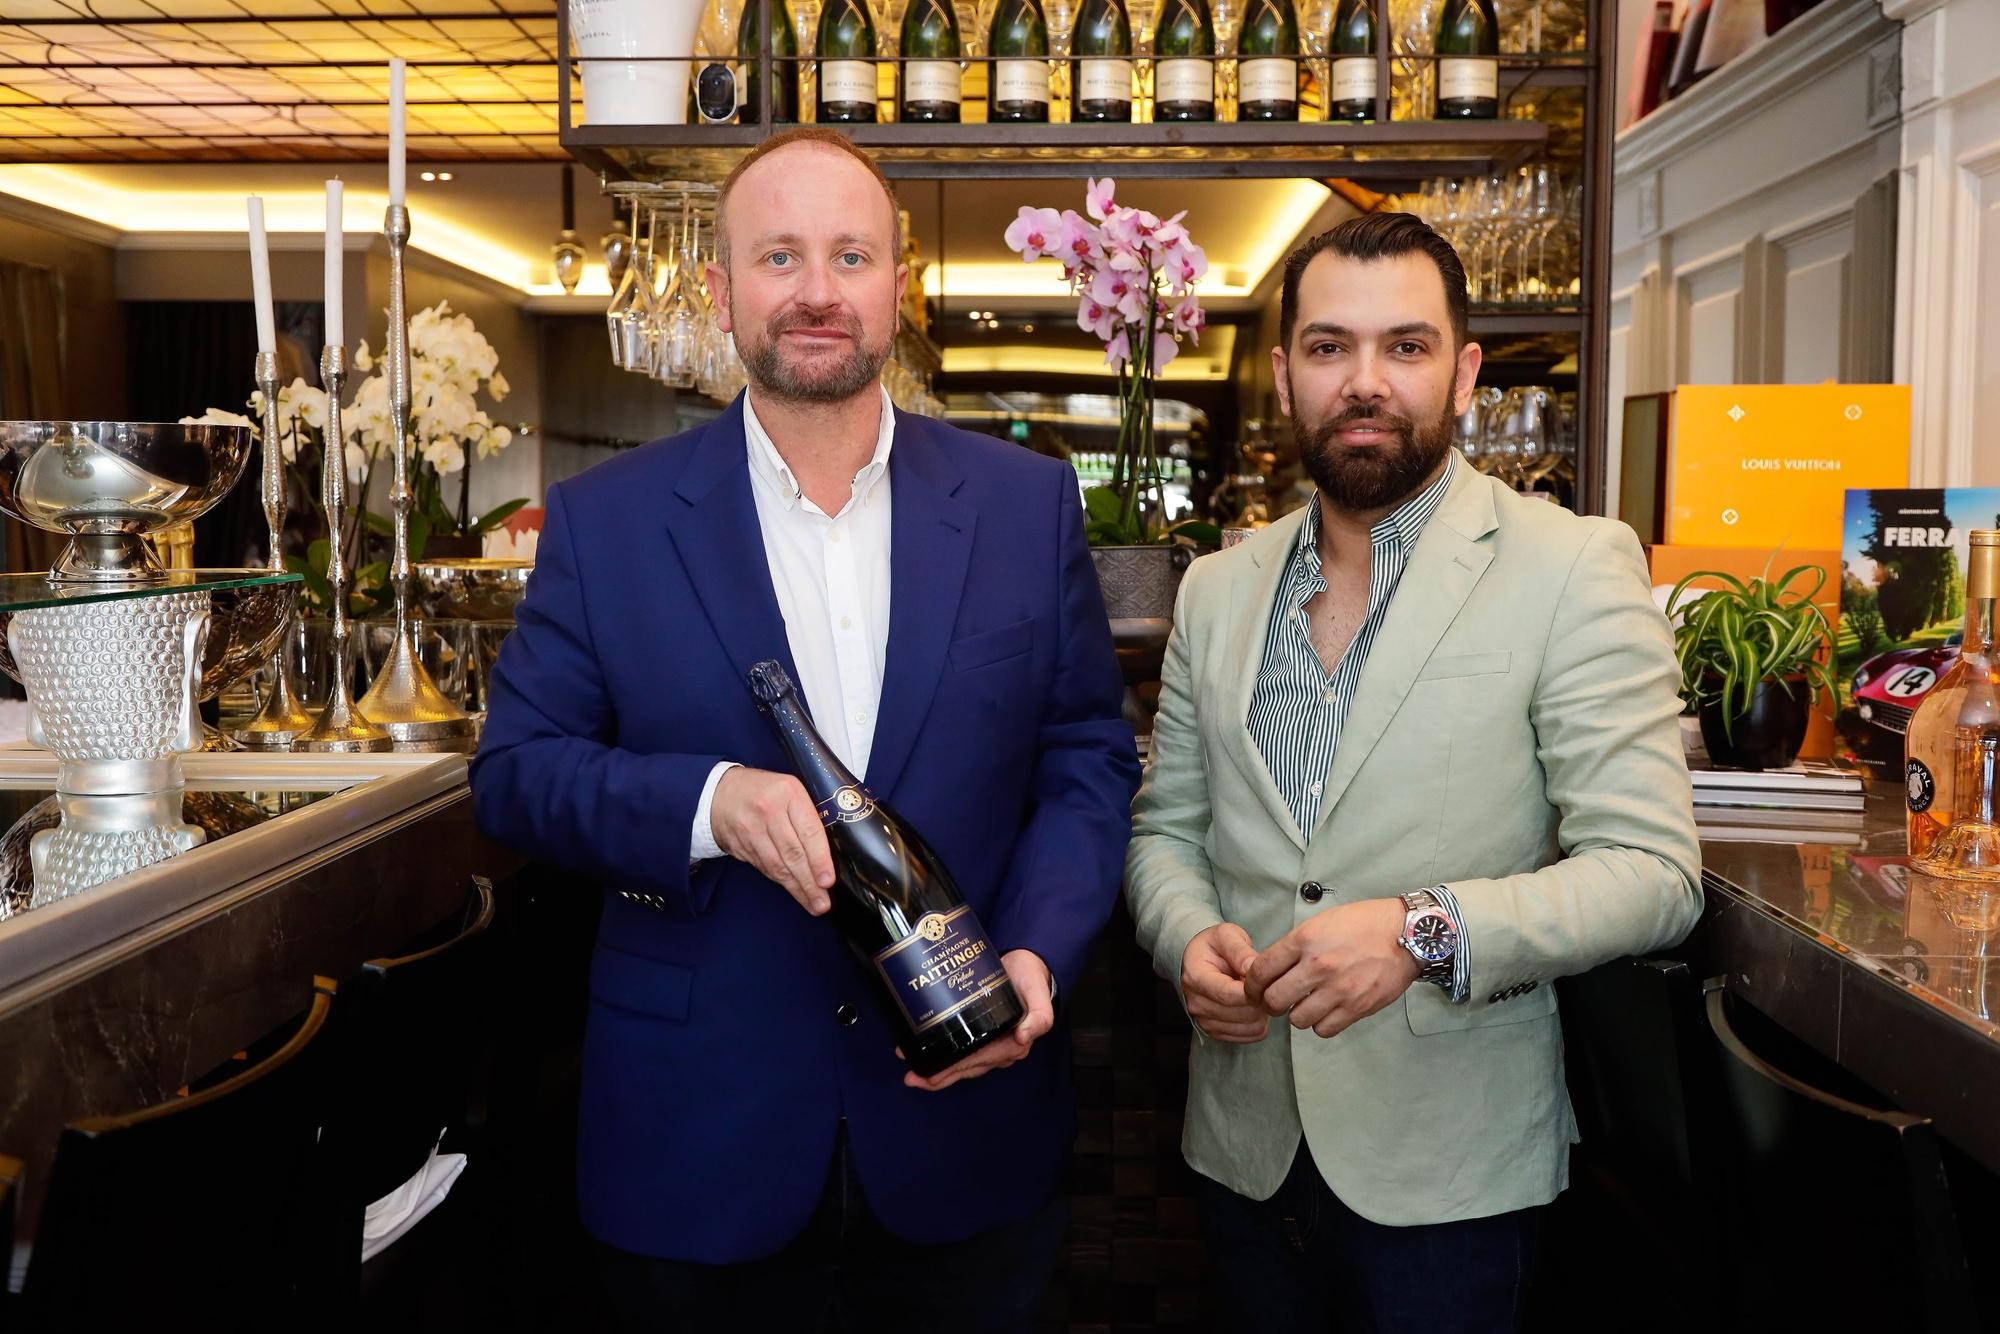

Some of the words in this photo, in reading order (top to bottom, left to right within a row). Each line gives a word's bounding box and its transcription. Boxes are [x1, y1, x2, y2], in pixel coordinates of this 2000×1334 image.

[1742, 459, 1780, 470] LOUIS
[1784, 459, 1841, 470] VUITTON
[1883, 526, 1960, 548] FERRA
[1888, 668, 1932, 695] 14
[908, 940, 988, 992] TAITTINGER
[921, 937, 970, 969] CHAMPAGNE
